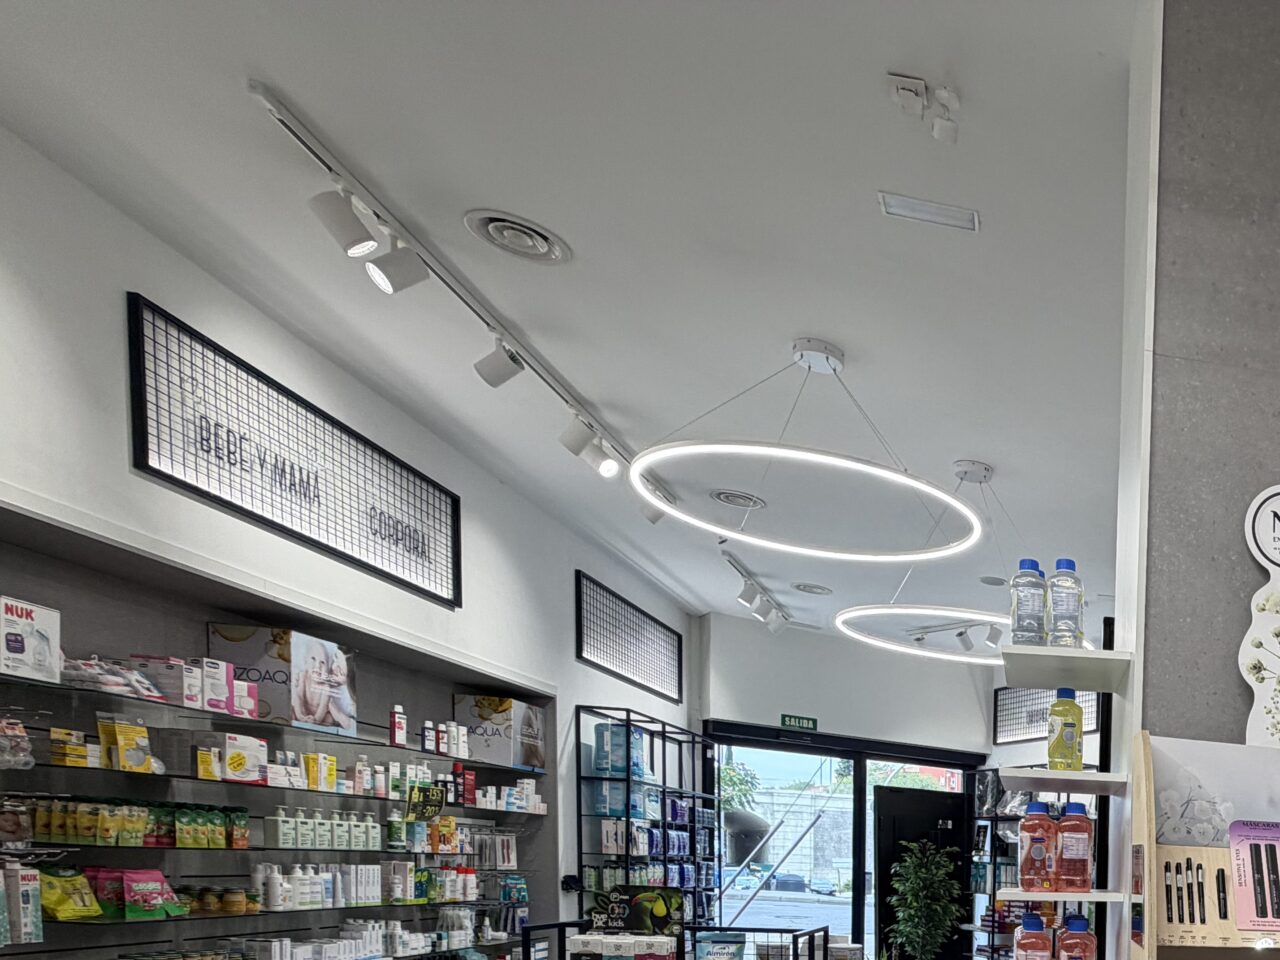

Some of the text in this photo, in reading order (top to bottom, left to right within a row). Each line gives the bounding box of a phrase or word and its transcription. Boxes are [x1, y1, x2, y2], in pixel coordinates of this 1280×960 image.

[199, 414, 251, 473] BEBÉ
[256, 442, 268, 473] Y
[368, 505, 434, 565] CORPORAL
[4, 602, 35, 621] NUK
[784, 716, 814, 729] SALIDA
[20, 873, 39, 883] NUK
[608, 918, 625, 928] kids
[706, 948, 735, 958] Almirón
